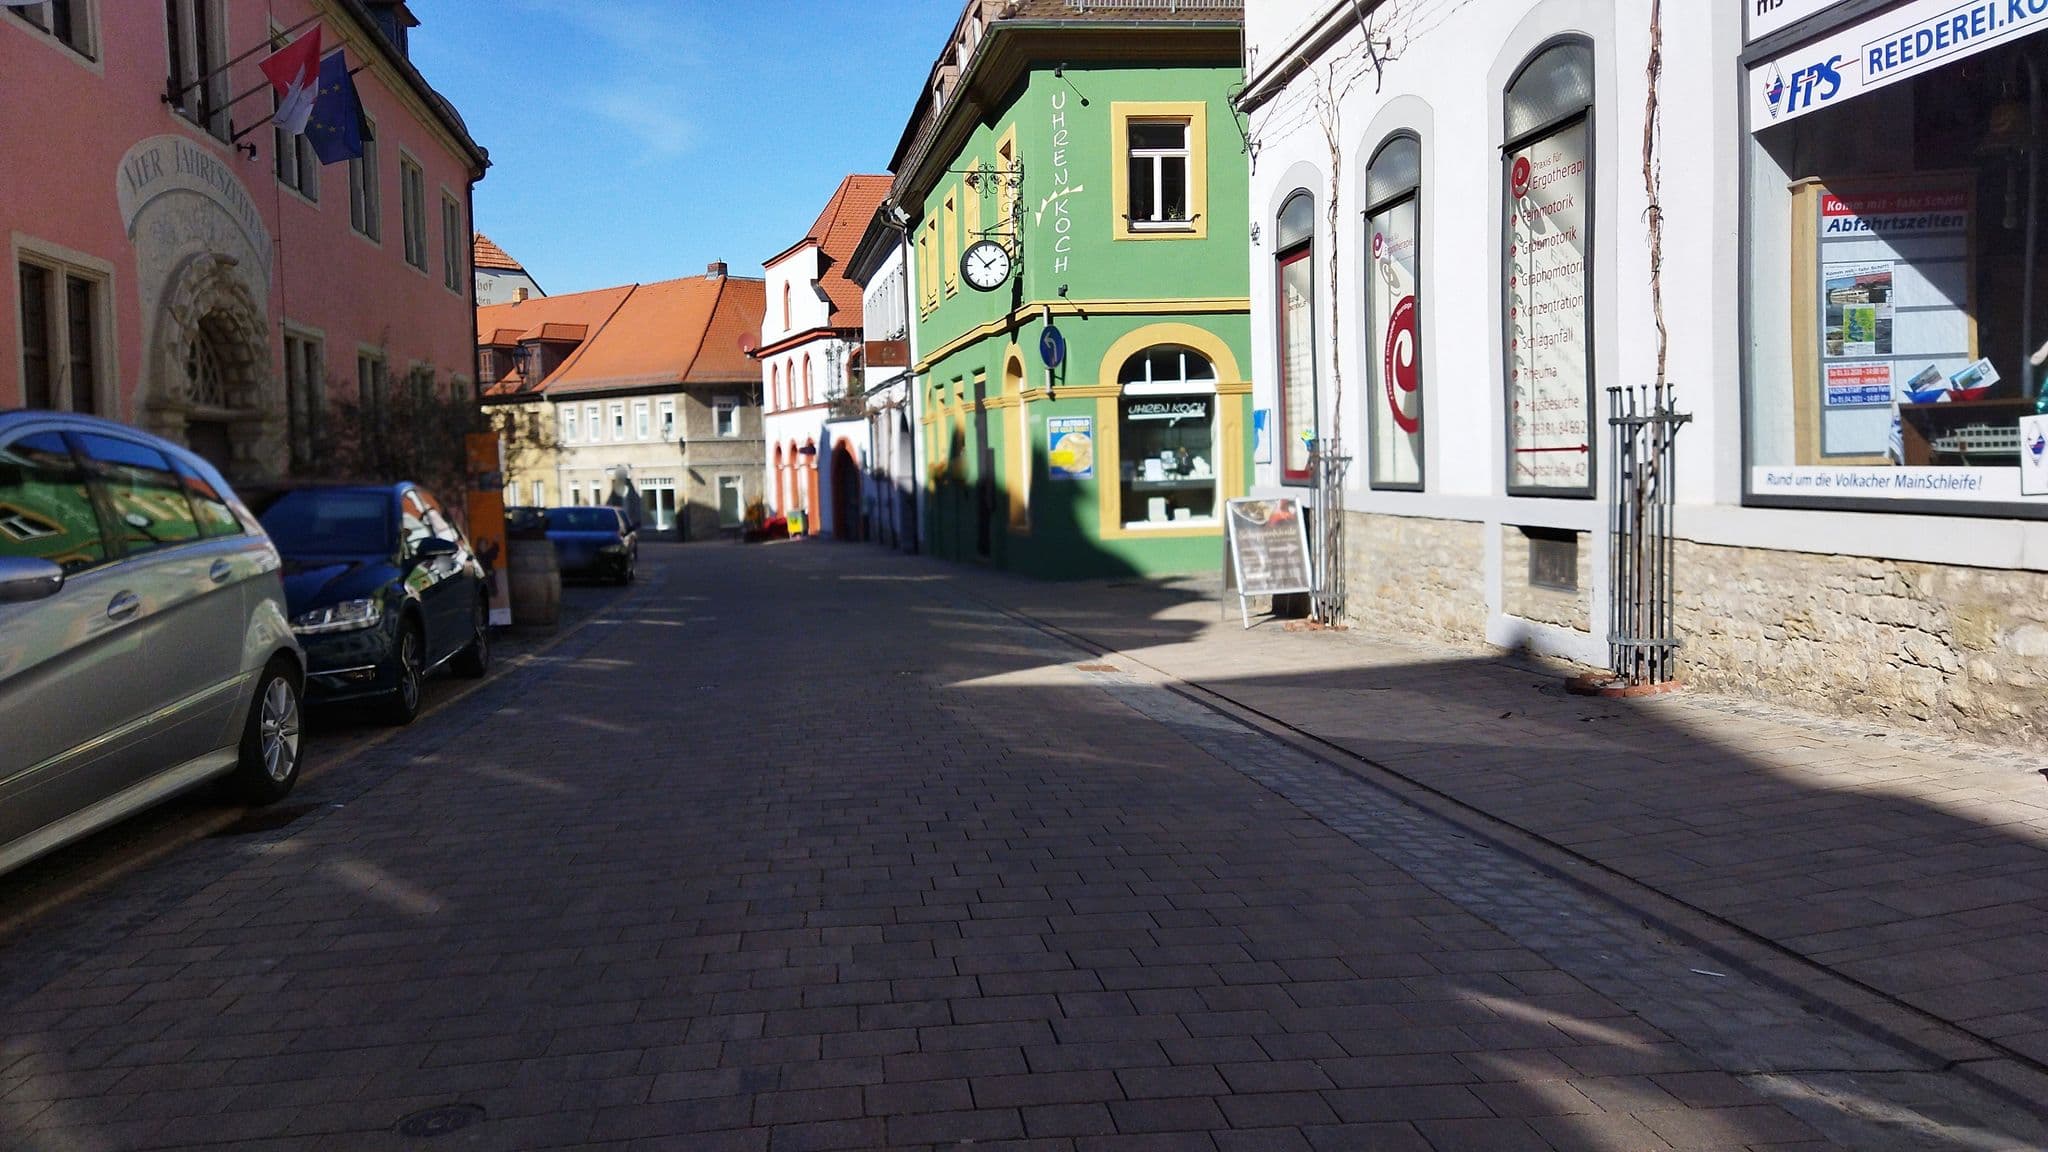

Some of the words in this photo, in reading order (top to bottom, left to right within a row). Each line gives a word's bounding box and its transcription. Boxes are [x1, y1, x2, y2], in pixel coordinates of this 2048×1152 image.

[1787, 55, 1842, 113] FPS
[1522, 194, 1575, 223] Feinmotorik
[1827, 214, 1964, 233] Abfahrtszeiten
[1054, 198, 1072, 274] KOCH
[1522, 294, 1584, 318] Konzentration
[1522, 328, 1574, 350] Schlaganfall
[1128, 402, 1170, 414] UHREN
[1171, 401, 1206, 414] KOCH
[1767, 473, 1793, 486] Rund
[1796, 476, 1812, 486] um
[1815, 473, 1832, 487] die
[1836, 473, 1891, 489] Volkacher
[1894, 474, 1984, 491] MainSchleife!
